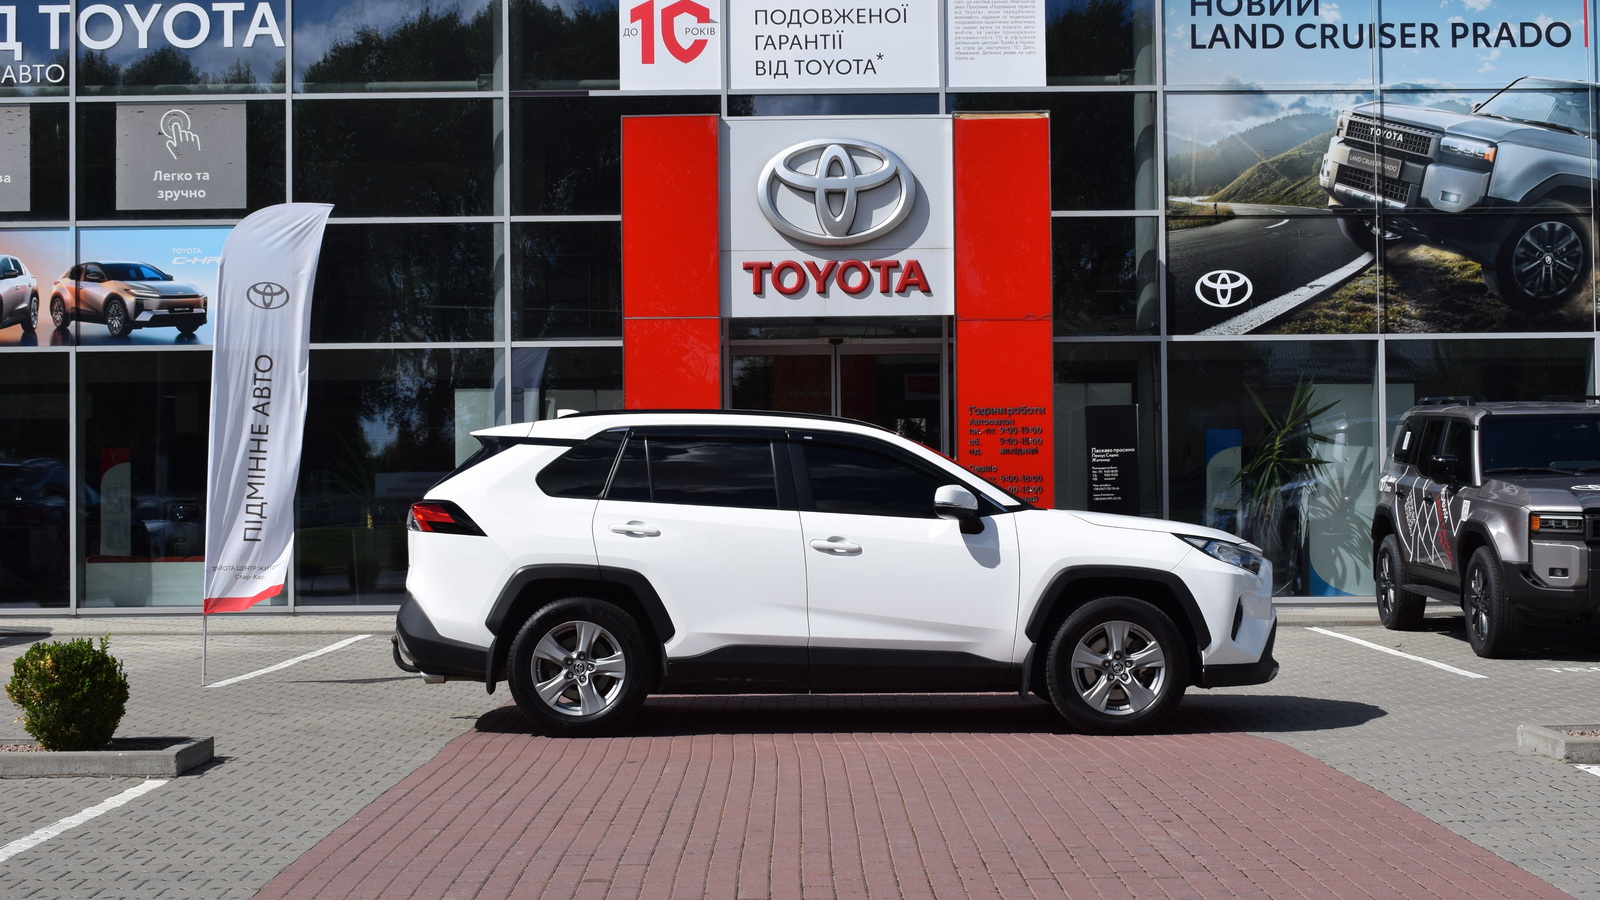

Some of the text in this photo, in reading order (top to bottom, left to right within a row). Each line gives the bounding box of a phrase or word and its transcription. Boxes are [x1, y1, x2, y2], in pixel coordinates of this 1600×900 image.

[754, 4, 908, 28] ПОДОВЖЕНОЇ
[38, 2, 285, 50] TOYOTA
[623, 28, 638, 38] ДО
[685, 26, 716, 36] РОКІВ
[1191, 22, 1572, 49] LAND CRUISER PRADO
[755, 30, 844, 50] ГАРАНТІЇ
[1, 64, 65, 84] АВТО
[755, 60, 788, 79] ВІД
[1370, 128, 1403, 142] TOYOTA
[153, 170, 210, 182] Легко та
[157, 188, 206, 201] зручно
[742, 260, 932, 295] TOYOTA
[968, 405, 1045, 417] Години роботи
[243, 354, 273, 542] ПІДМІННЕ АВТО
[1000, 447, 1038, 455] вихідний
[969, 464, 997, 474] Сервіс
